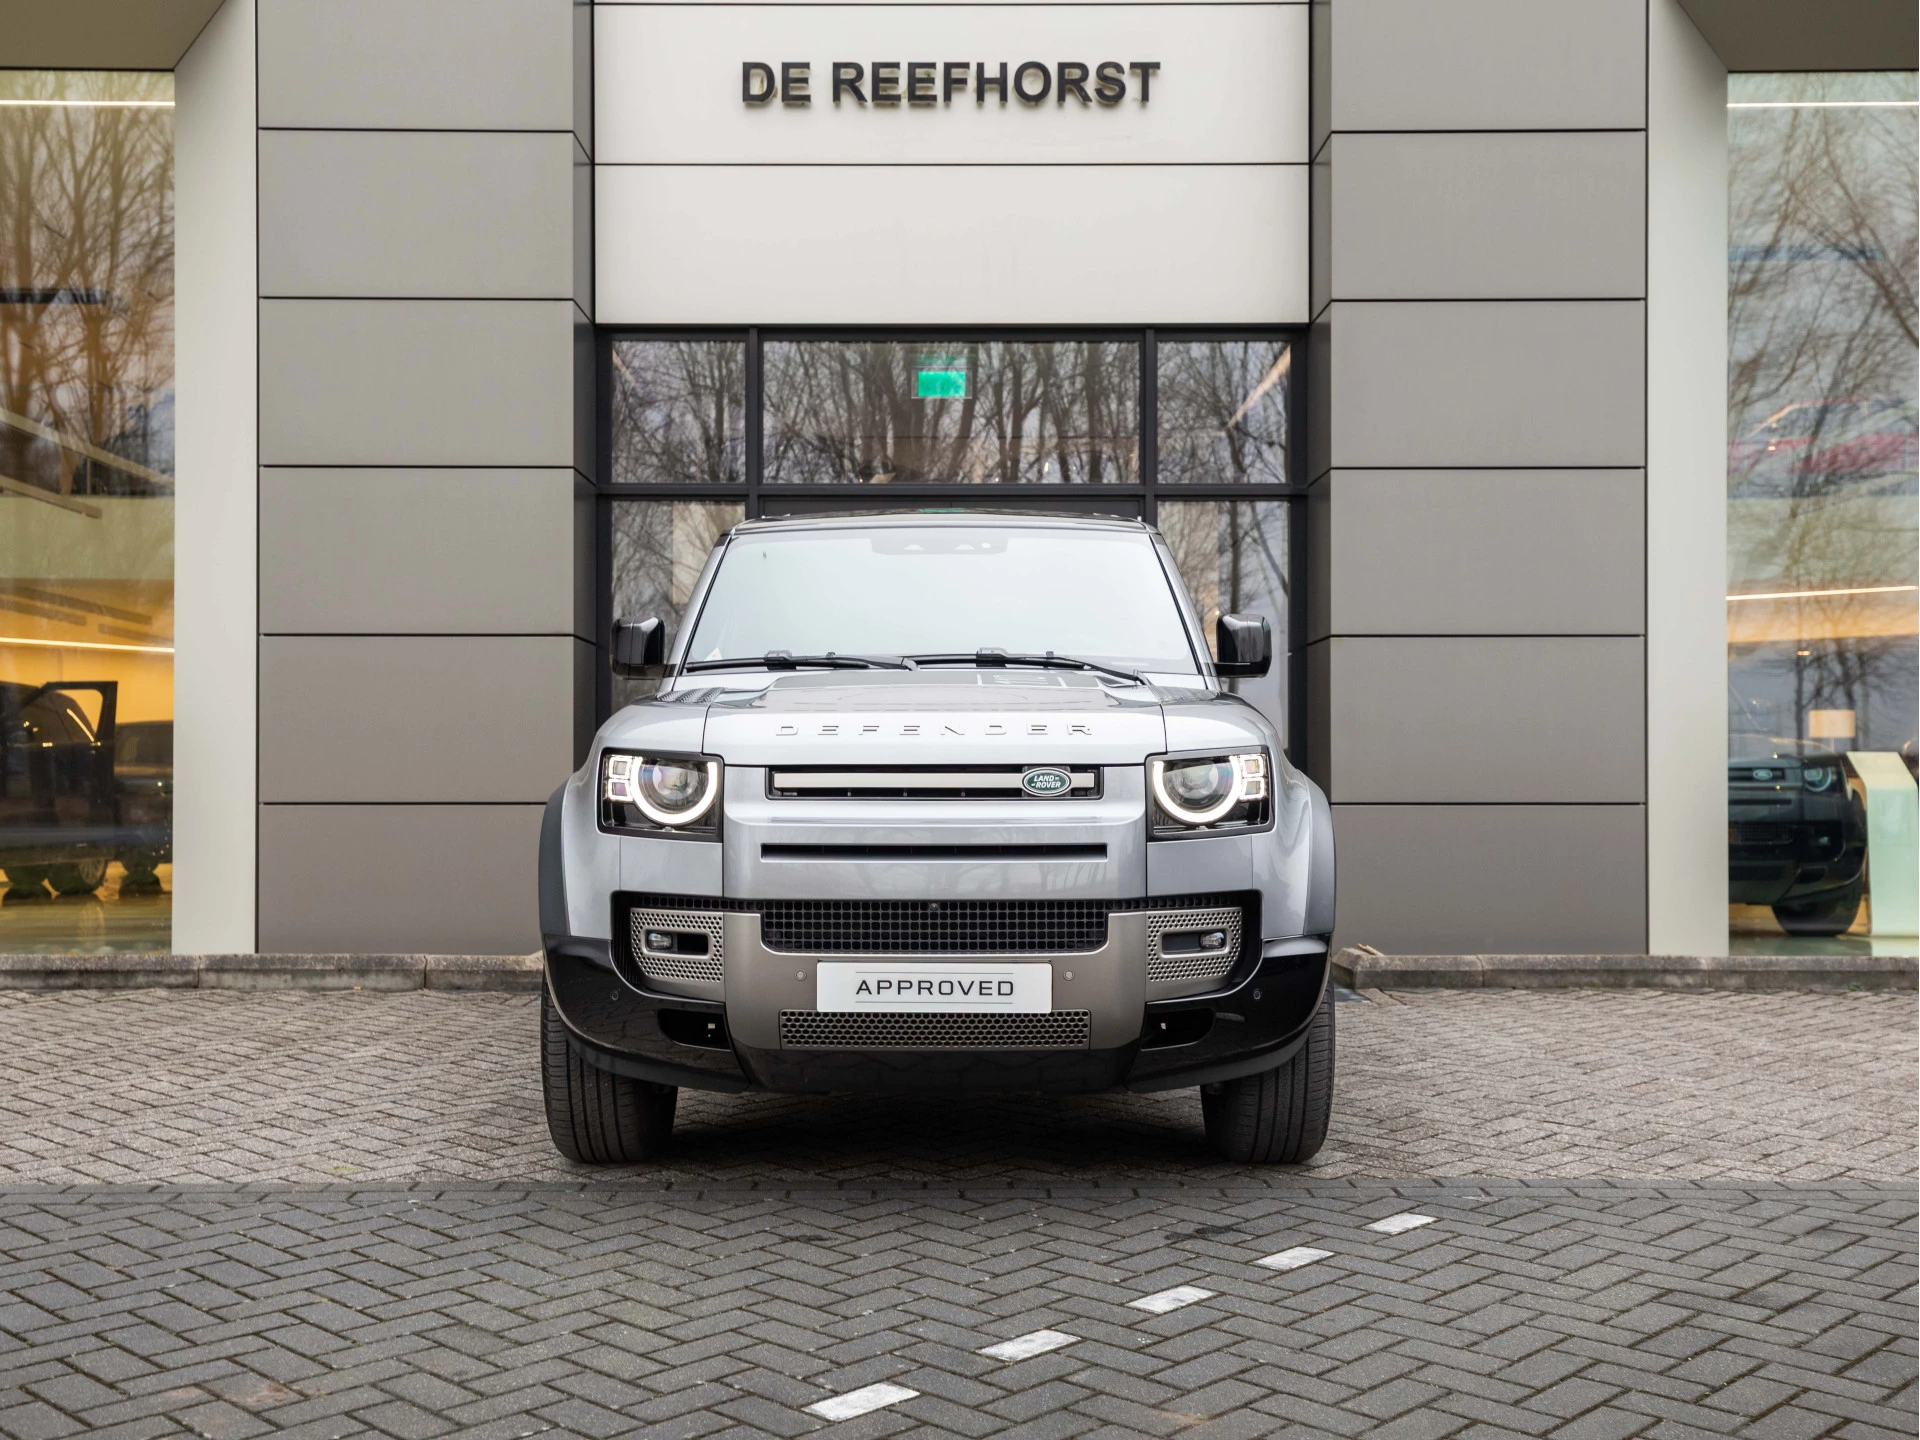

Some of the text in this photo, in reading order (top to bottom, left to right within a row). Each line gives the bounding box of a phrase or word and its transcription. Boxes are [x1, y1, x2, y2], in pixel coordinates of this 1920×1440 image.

[742, 61, 1161, 104] DE REEFHORST
[775, 724, 1093, 736] DEFENDER
[856, 980, 1014, 996] APPROVED
